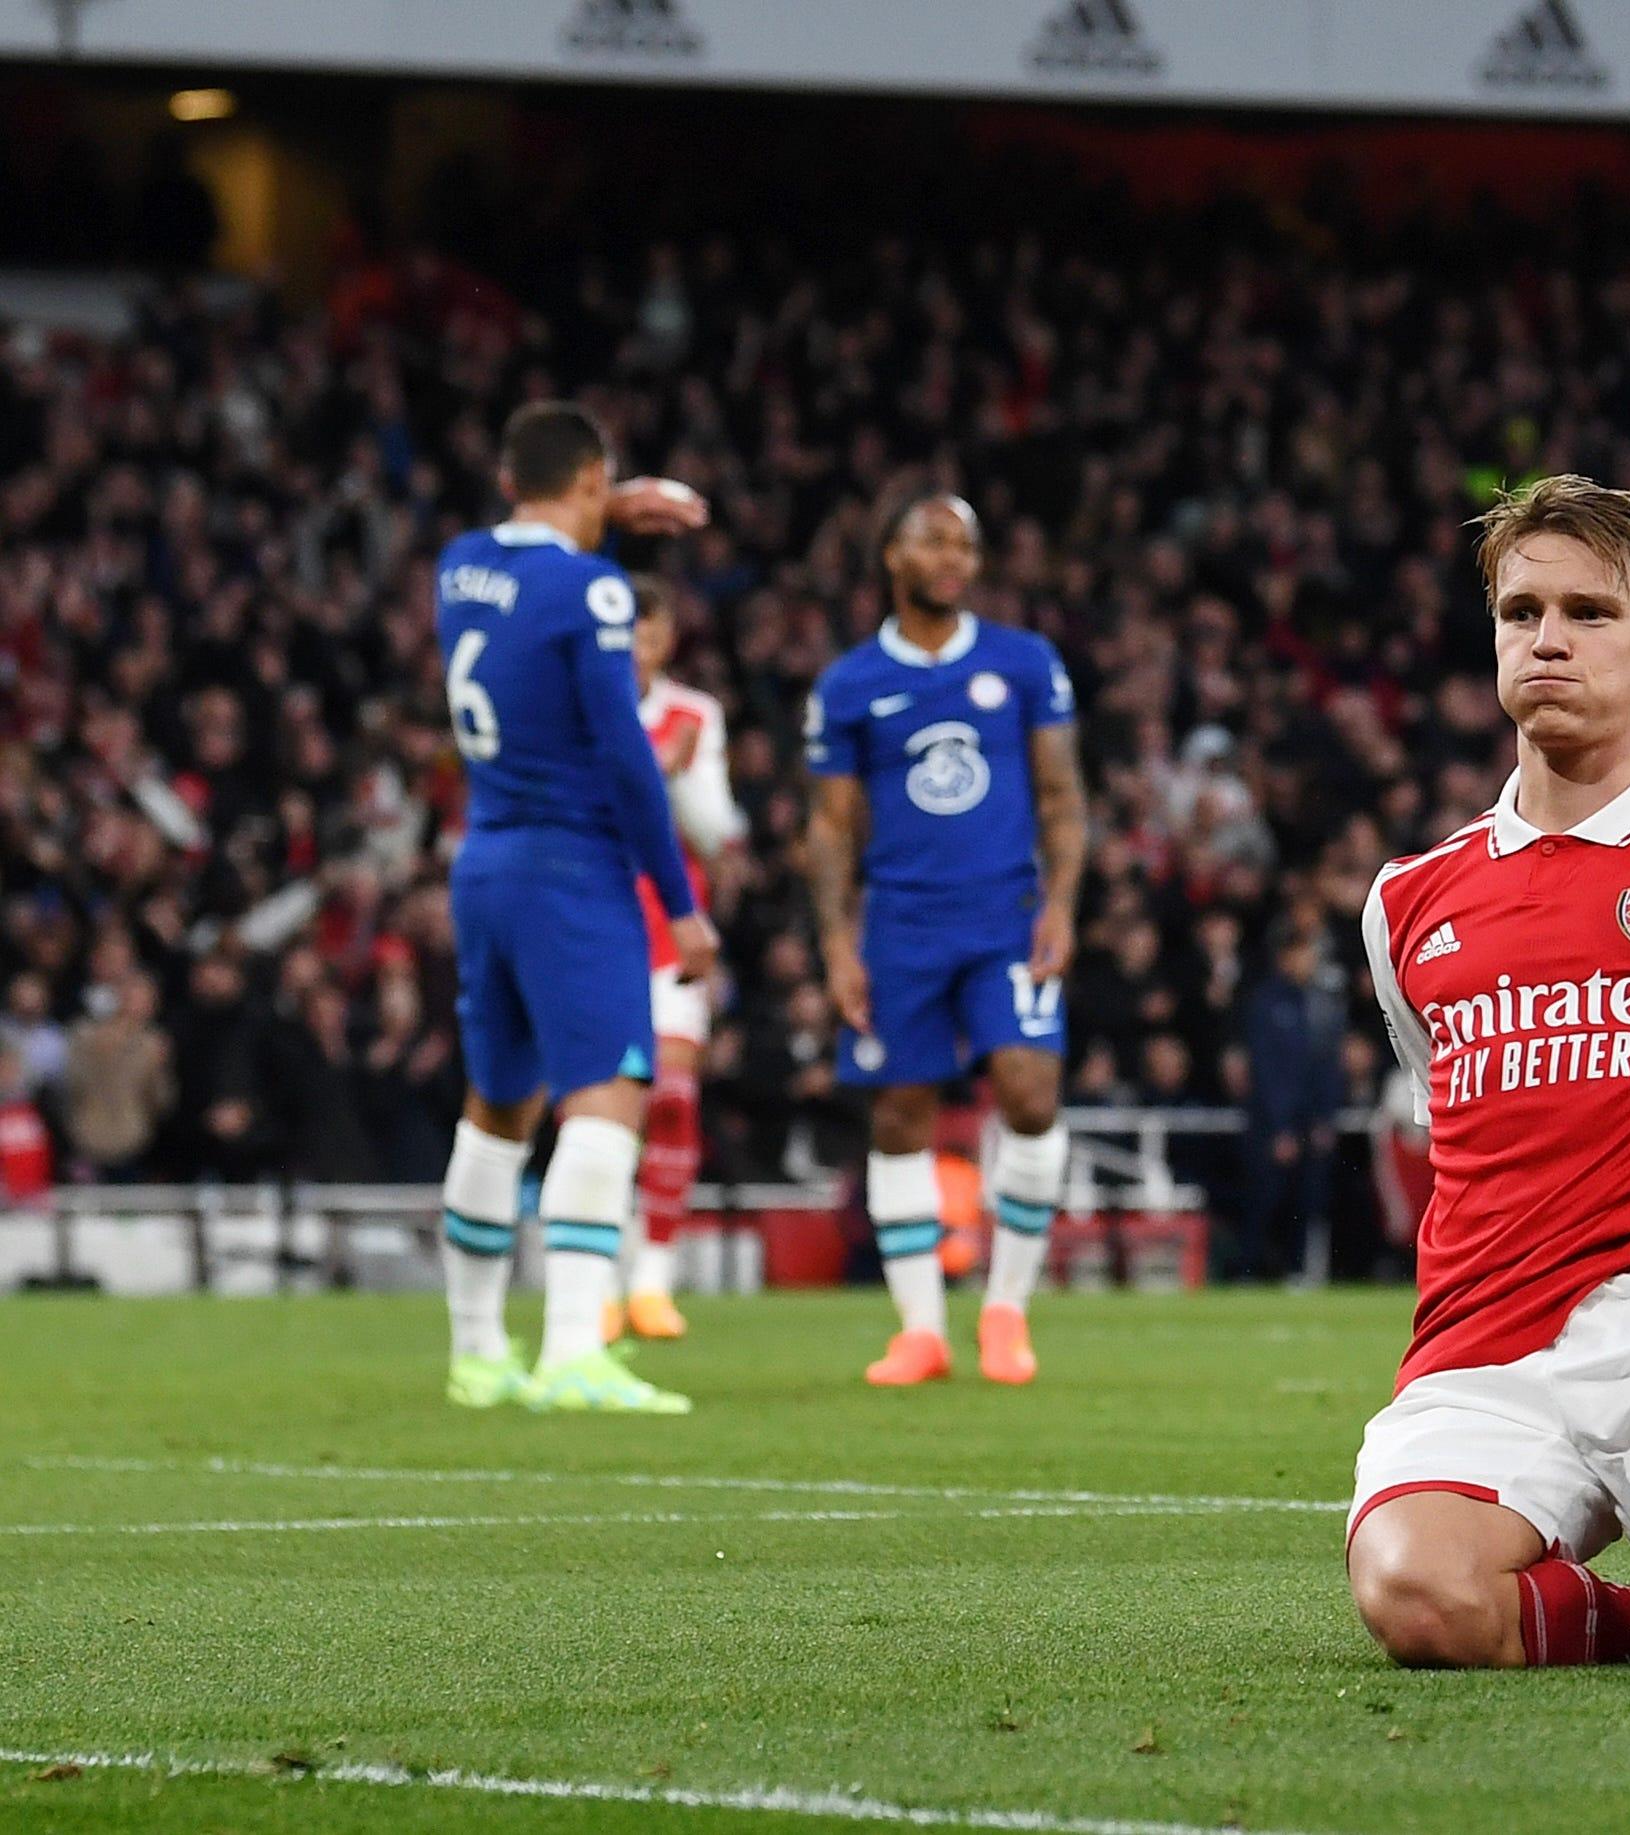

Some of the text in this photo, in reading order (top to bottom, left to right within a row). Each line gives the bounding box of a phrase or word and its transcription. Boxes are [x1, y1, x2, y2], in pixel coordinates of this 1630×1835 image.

[446, 628, 499, 762] 6
[1416, 941, 1461, 965] adidas
[1447, 1047, 1490, 1108] FLY
